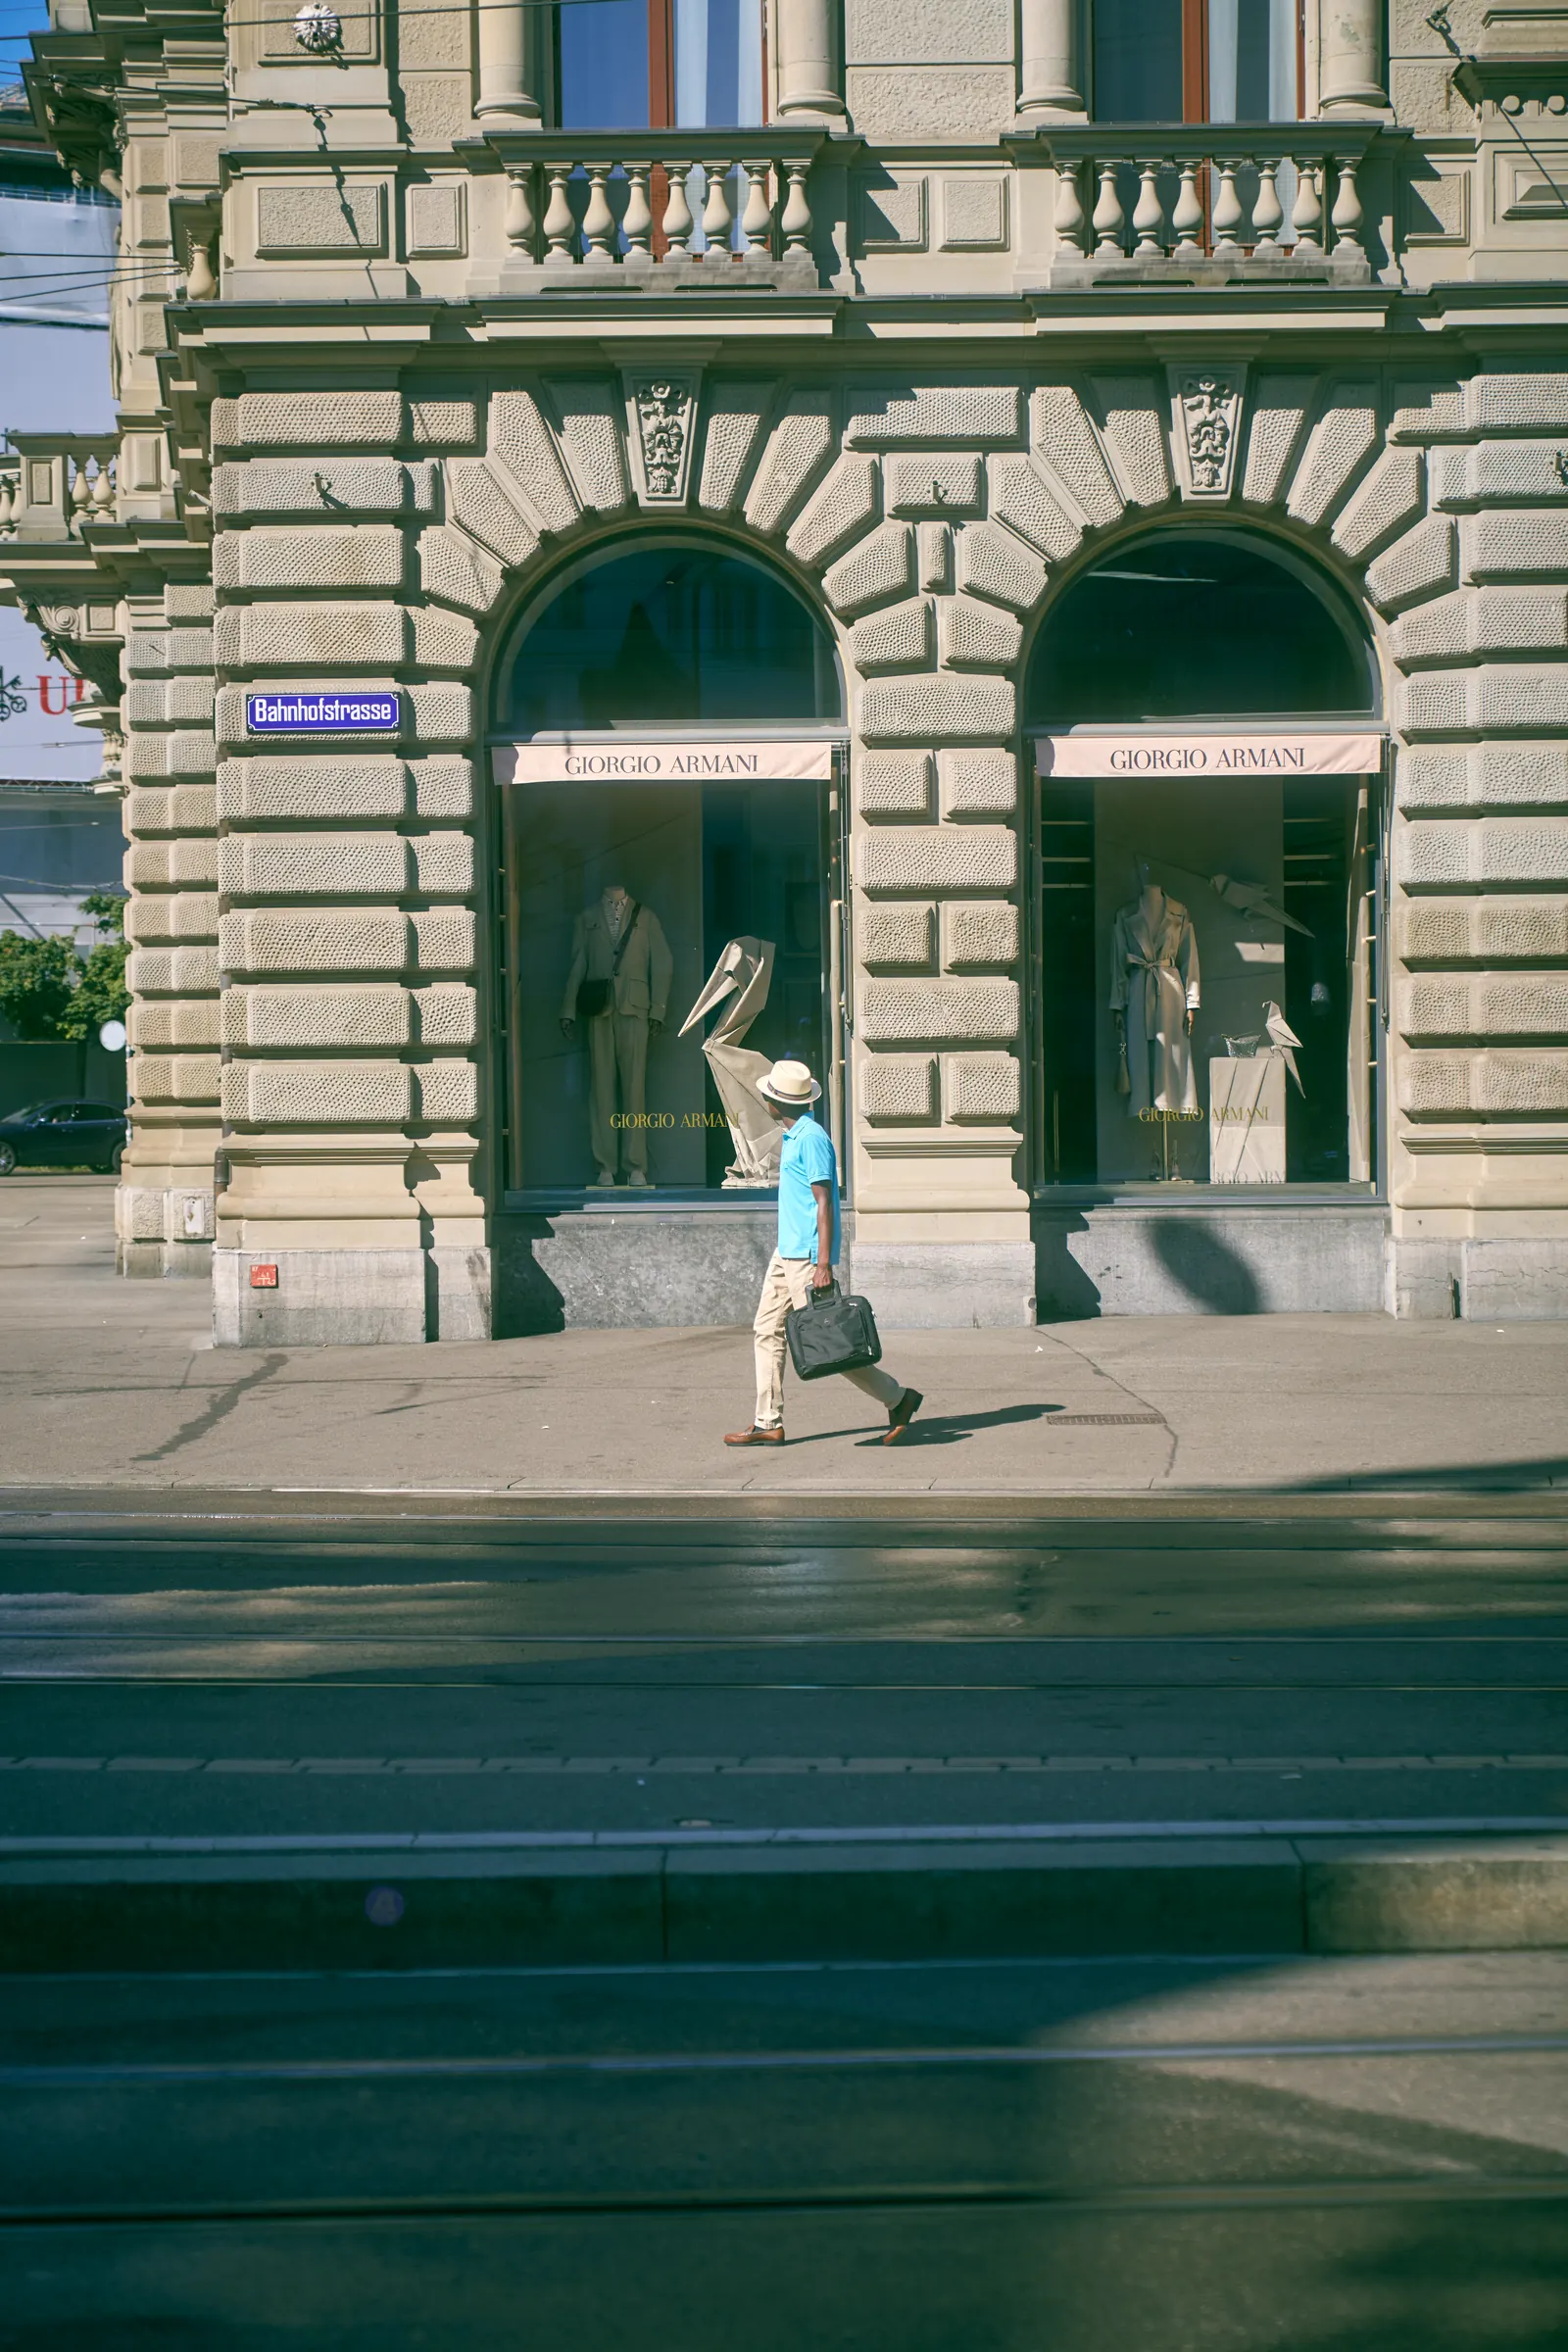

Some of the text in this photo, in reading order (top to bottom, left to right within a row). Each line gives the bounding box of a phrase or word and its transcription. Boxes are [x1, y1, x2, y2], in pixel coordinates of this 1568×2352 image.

[35, 675, 84, 714] U
[255, 698, 391, 723] Bahnhofstrasse
[564, 754, 759, 775] GIORGIO ARMANI
[1110, 747, 1305, 770] GIORGIO ARMANI
[610, 1112, 739, 1129] GIORGIO ARMANI
[1138, 1105, 1269, 1122] GIORGIO ARMANI
